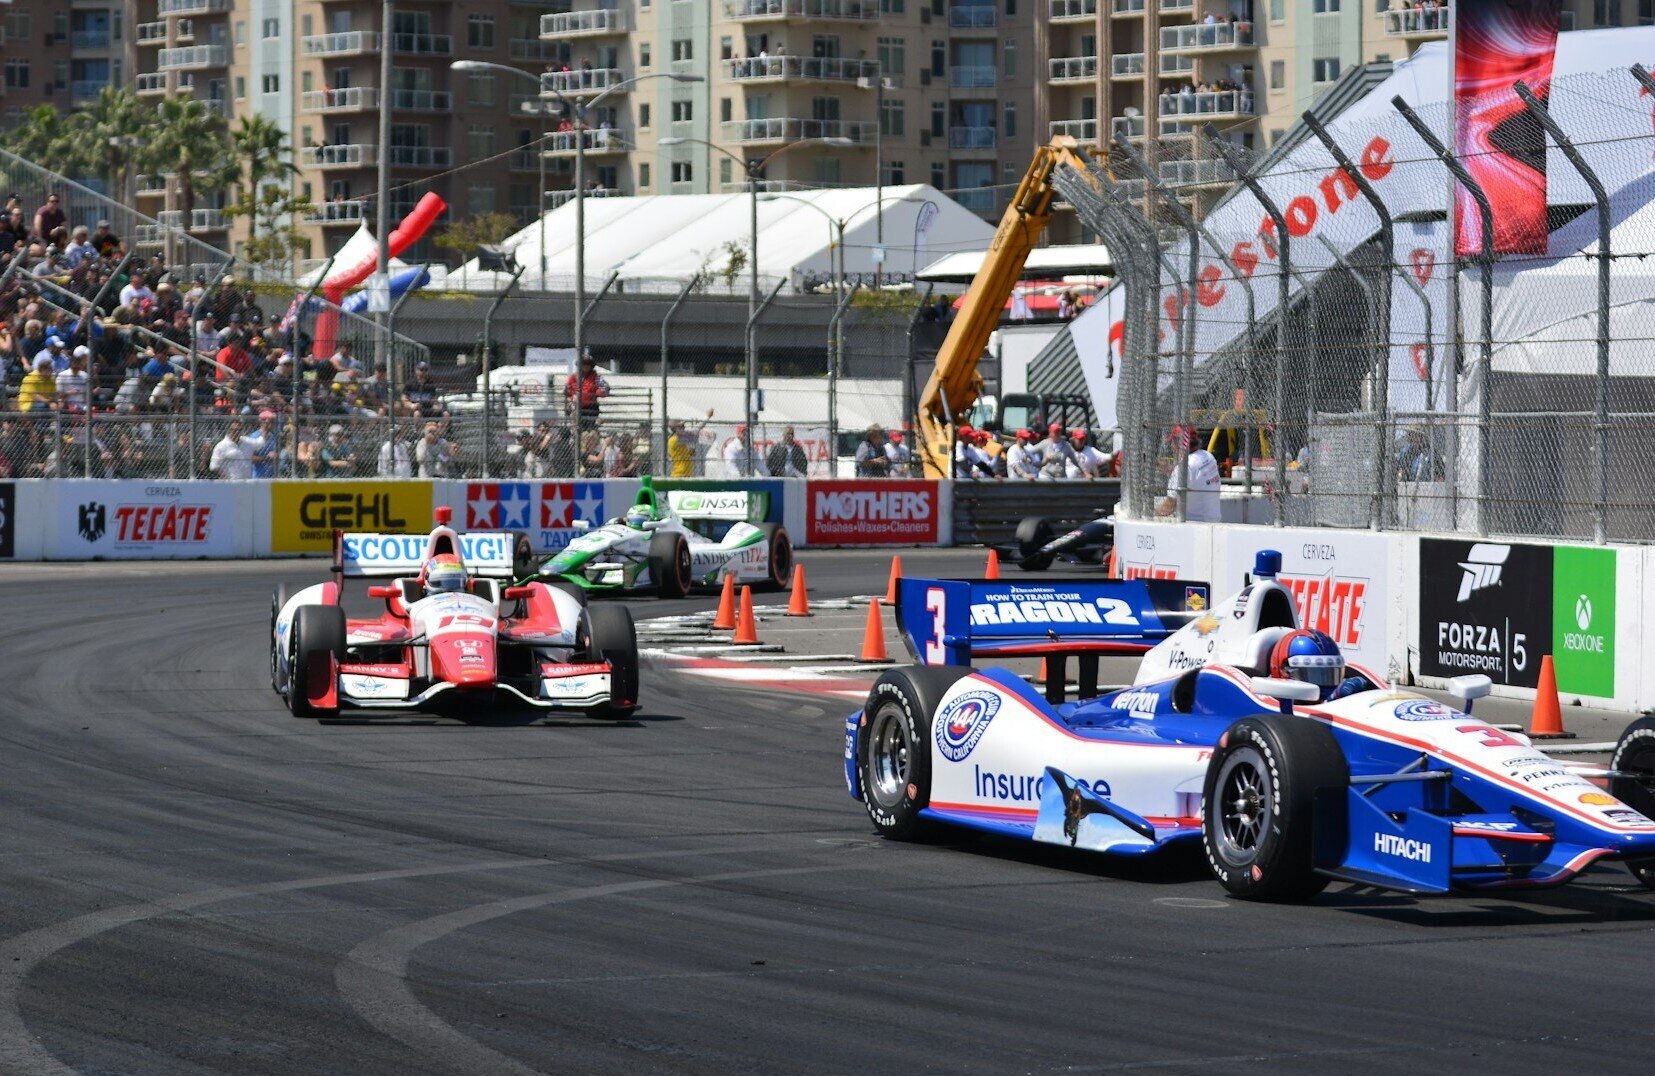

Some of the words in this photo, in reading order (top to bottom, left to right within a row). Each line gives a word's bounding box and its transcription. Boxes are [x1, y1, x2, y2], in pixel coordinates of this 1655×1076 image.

[145, 487, 181, 496] CERVEZA
[815, 491, 930, 519] MOTHERS
[115, 506, 211, 541] TECATE
[300, 493, 406, 528] GEHL
[343, 537, 504, 561] SCOUNG!
[1303, 543, 1336, 560] CERVEZA
[1026, 593, 1054, 601] TRAIN
[926, 587, 946, 666] 3
[970, 601, 1102, 626] RAGON
[1096, 598, 1140, 626] 2
[1438, 622, 1501, 652] FORZA
[1512, 633, 1527, 671] 5
[949, 707, 979, 728] AAA
[953, 719, 990, 760] CALIFORNIA
[1375, 832, 1432, 863] HITACHI
